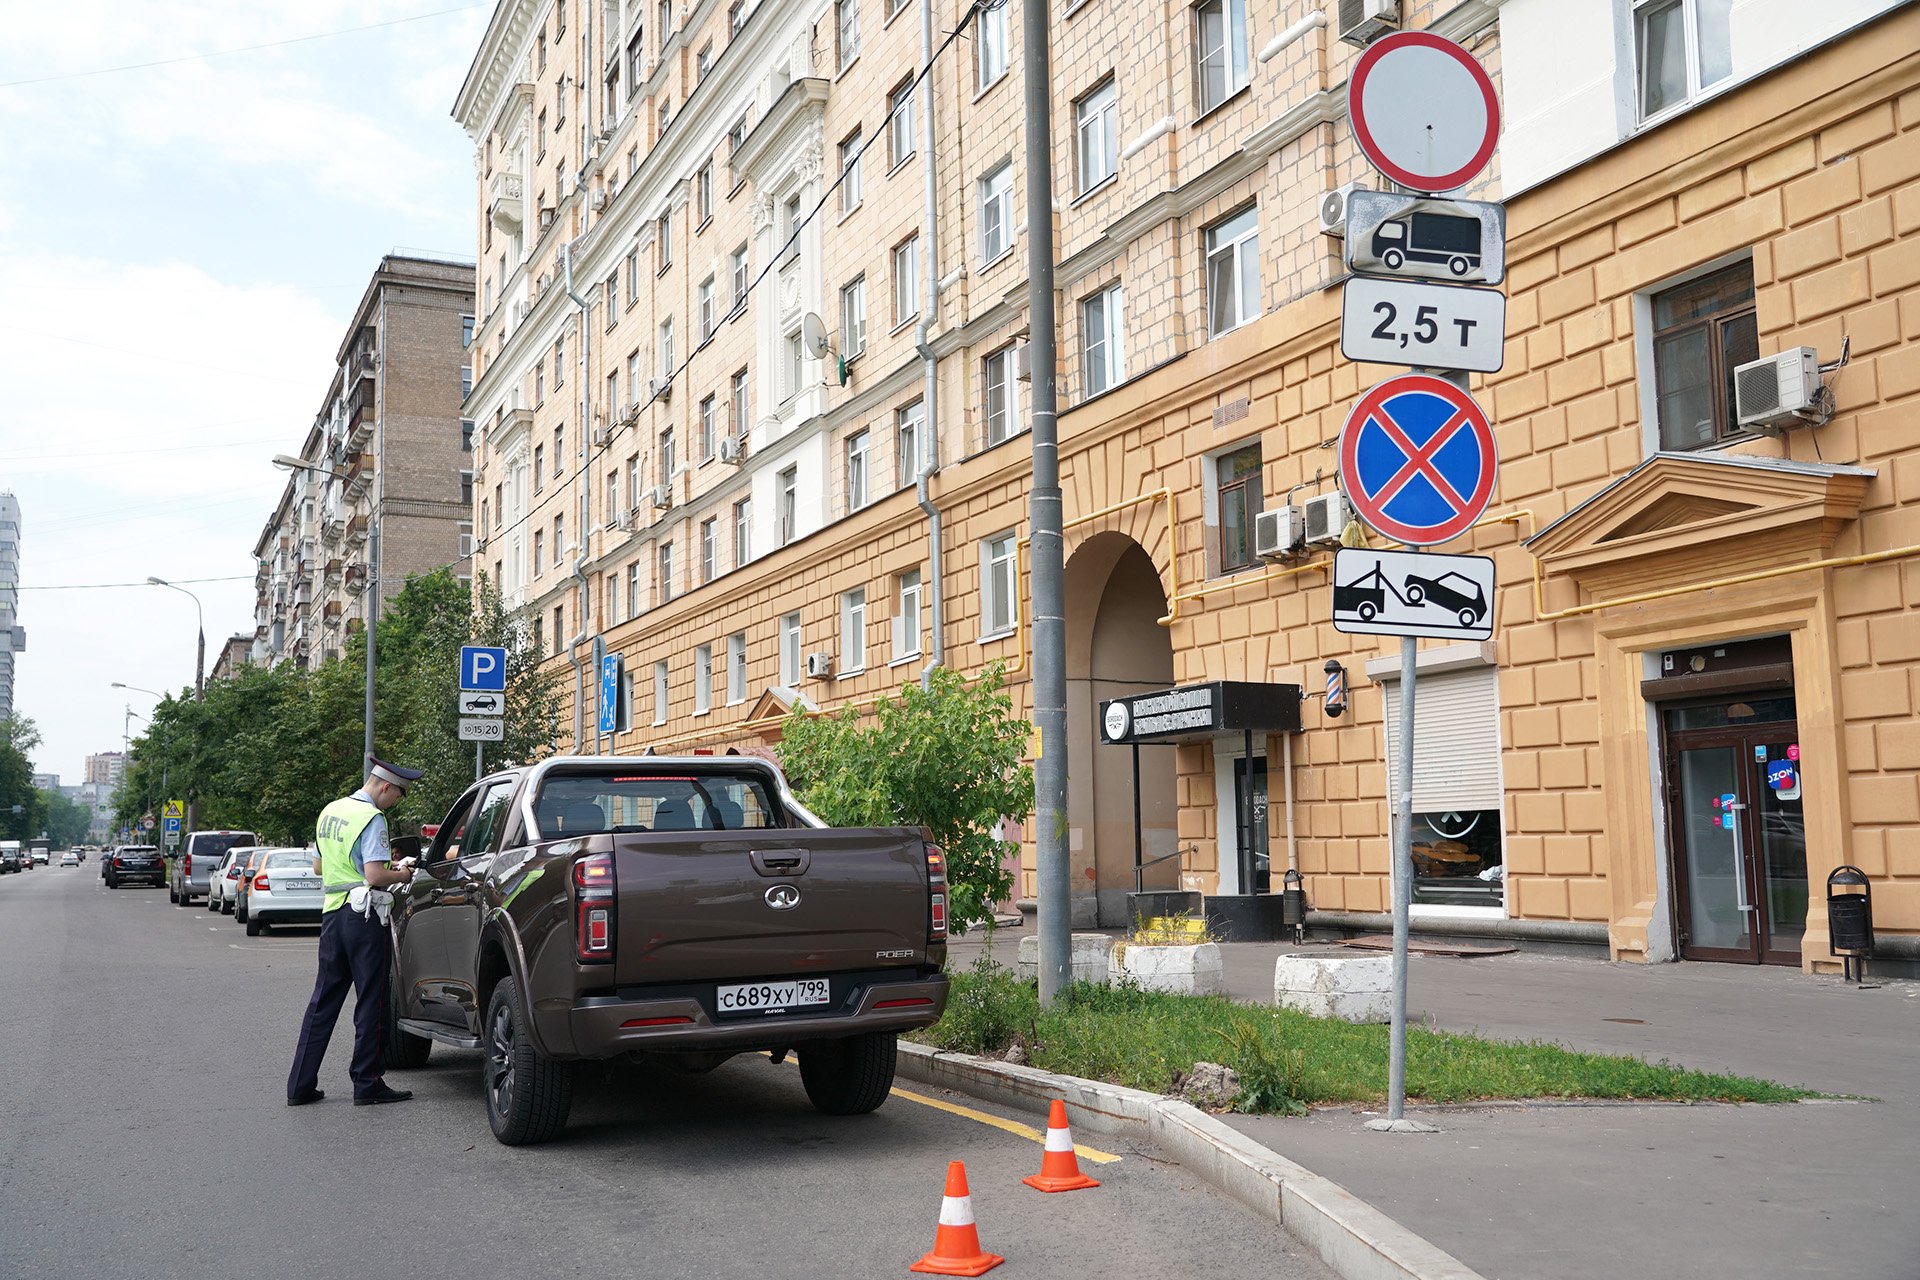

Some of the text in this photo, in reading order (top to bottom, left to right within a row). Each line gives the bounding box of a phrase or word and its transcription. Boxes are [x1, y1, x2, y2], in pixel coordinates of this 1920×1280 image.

[1371, 301, 1438, 349] 2,5
[472, 653, 496, 684] P
[473, 725, 483, 735] 15
[485, 725, 499, 735] 20
[169, 820, 178, 830] P
[318, 815, 349, 843] ДПС
[722, 981, 825, 1008] С689ХУ 799
